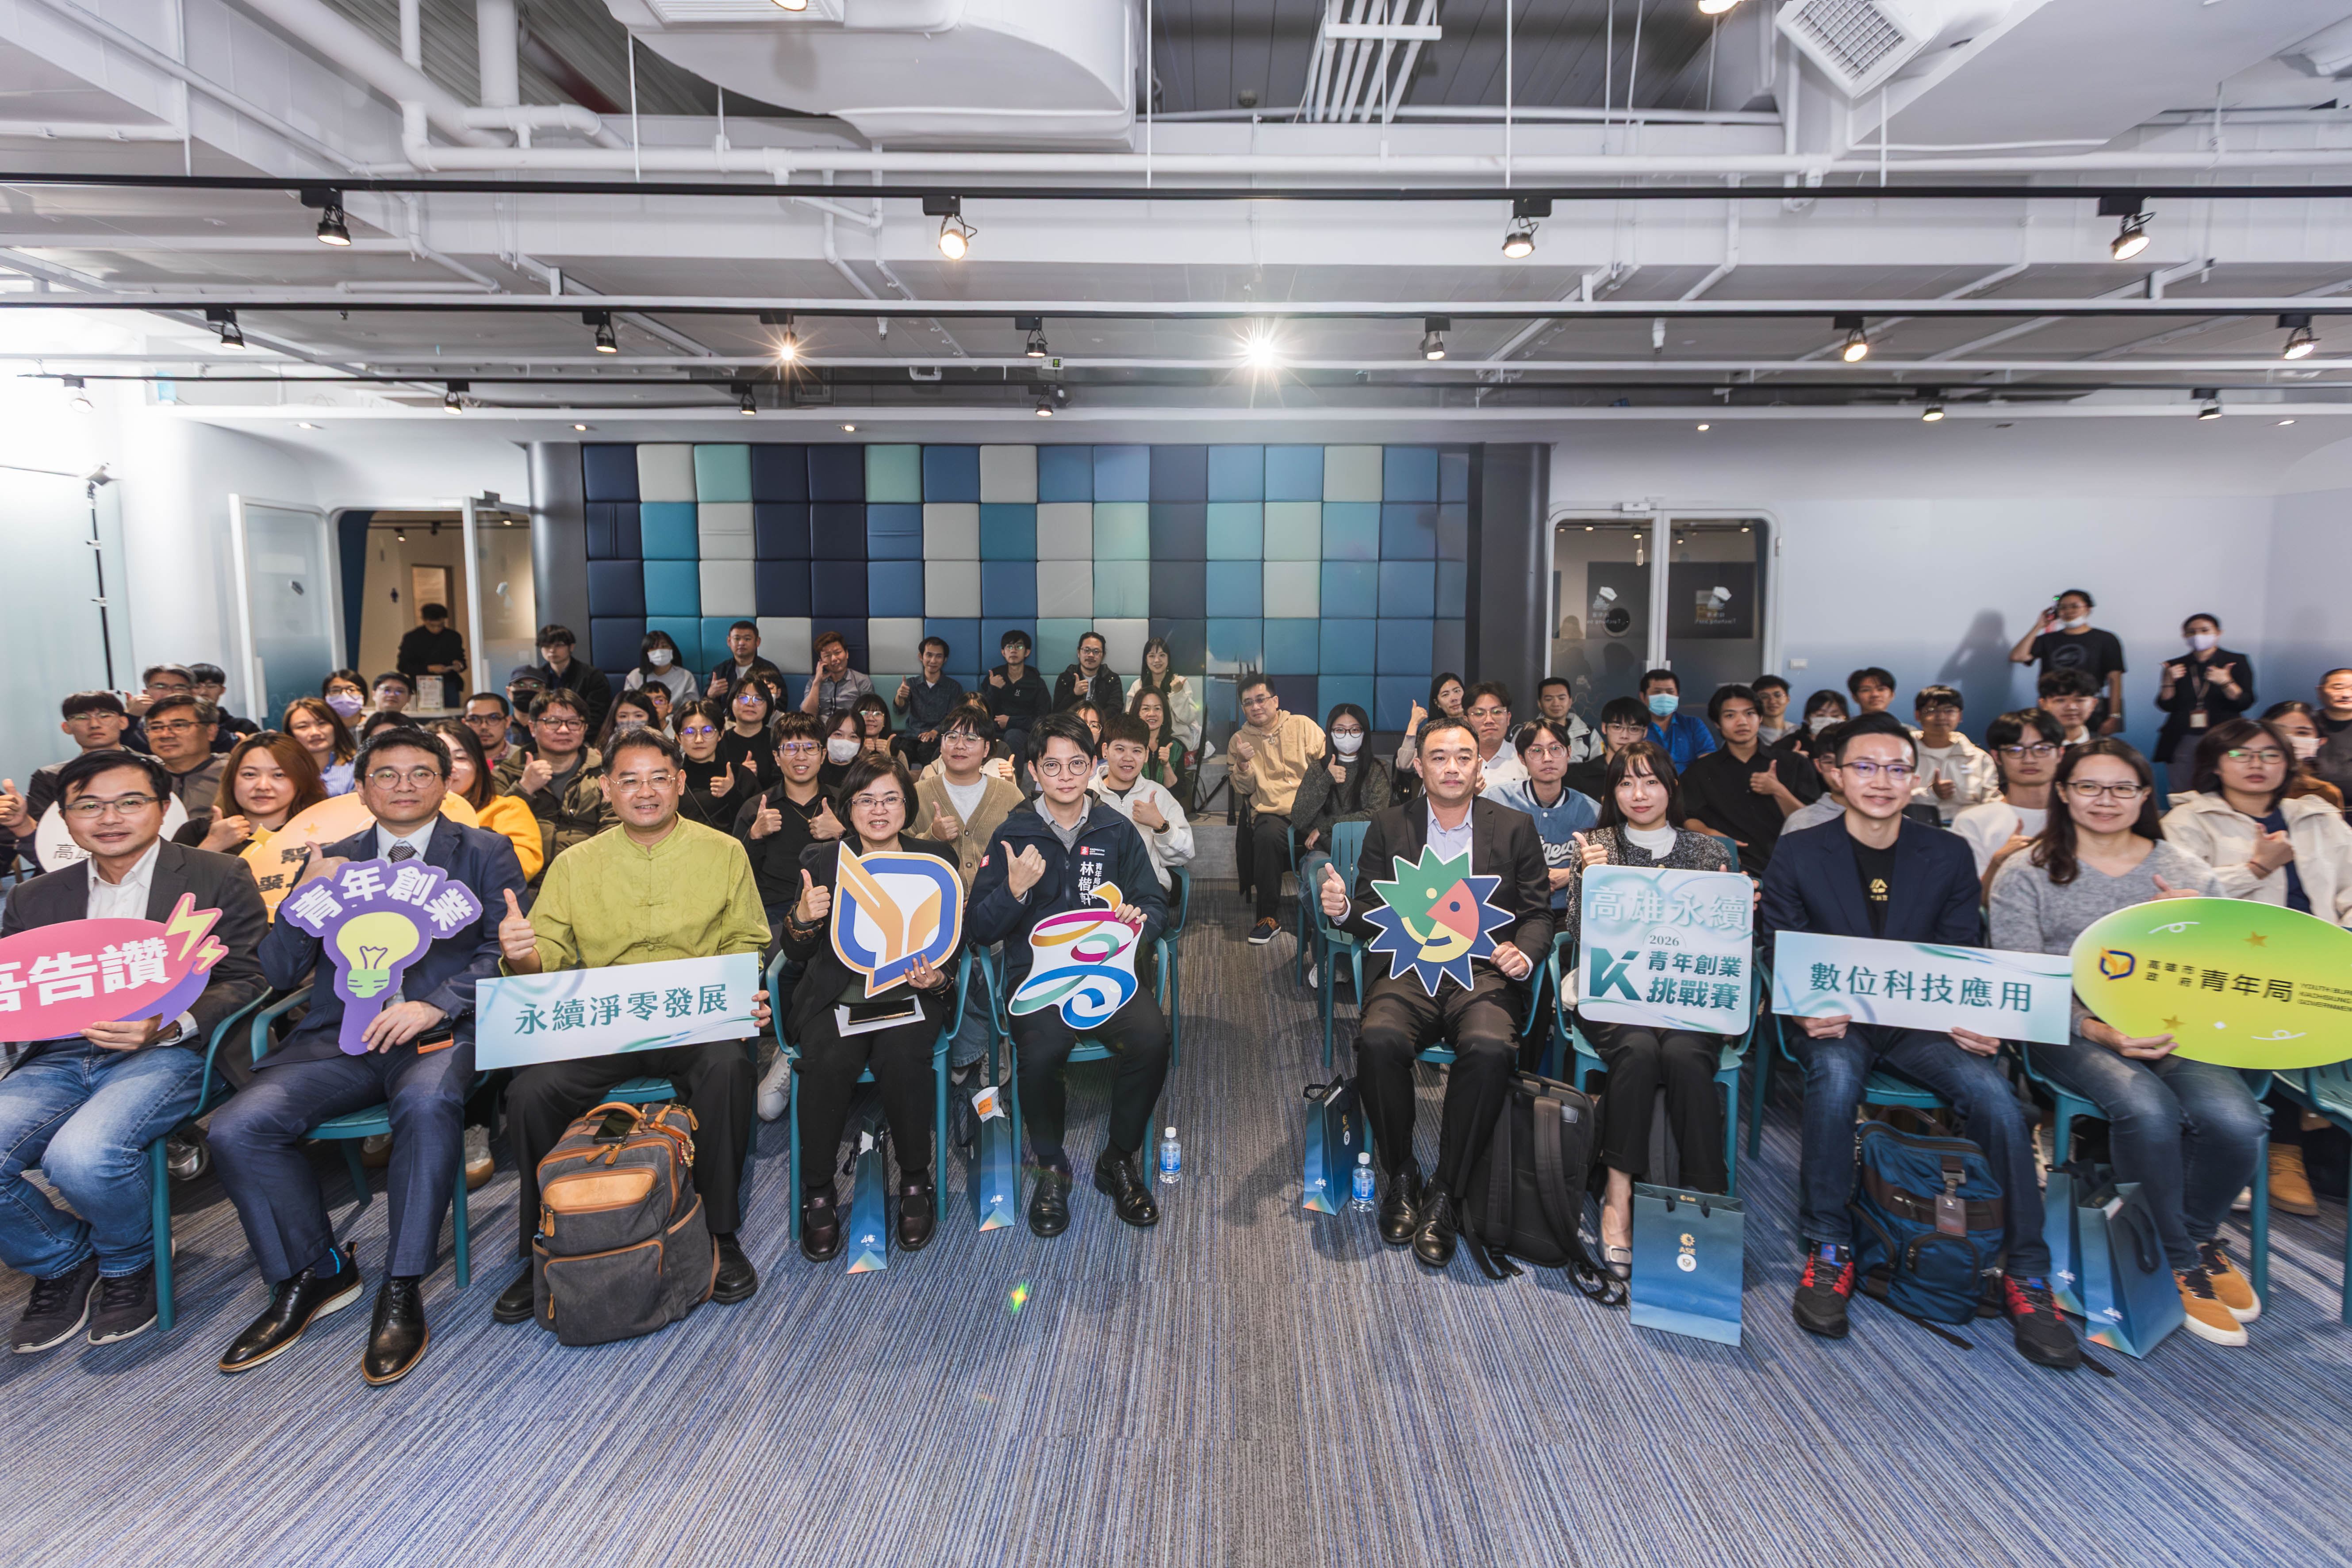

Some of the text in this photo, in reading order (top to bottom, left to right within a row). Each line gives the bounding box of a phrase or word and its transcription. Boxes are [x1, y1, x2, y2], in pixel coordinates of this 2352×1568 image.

[290, 866, 473, 931] 青年創業
[1589, 886, 1747, 931] 高雄永續
[1649, 935, 1680, 947] 2026
[1648, 950, 1743, 978] 青年創業
[1646, 977, 1741, 1011] 挑戰賽
[1810, 962, 2031, 1012] 數位科技應用
[2200, 969, 2293, 1002] 青年局
[514, 983, 728, 1035] 永續淨零發展
[1679, 1246, 1696, 1255] ASE
